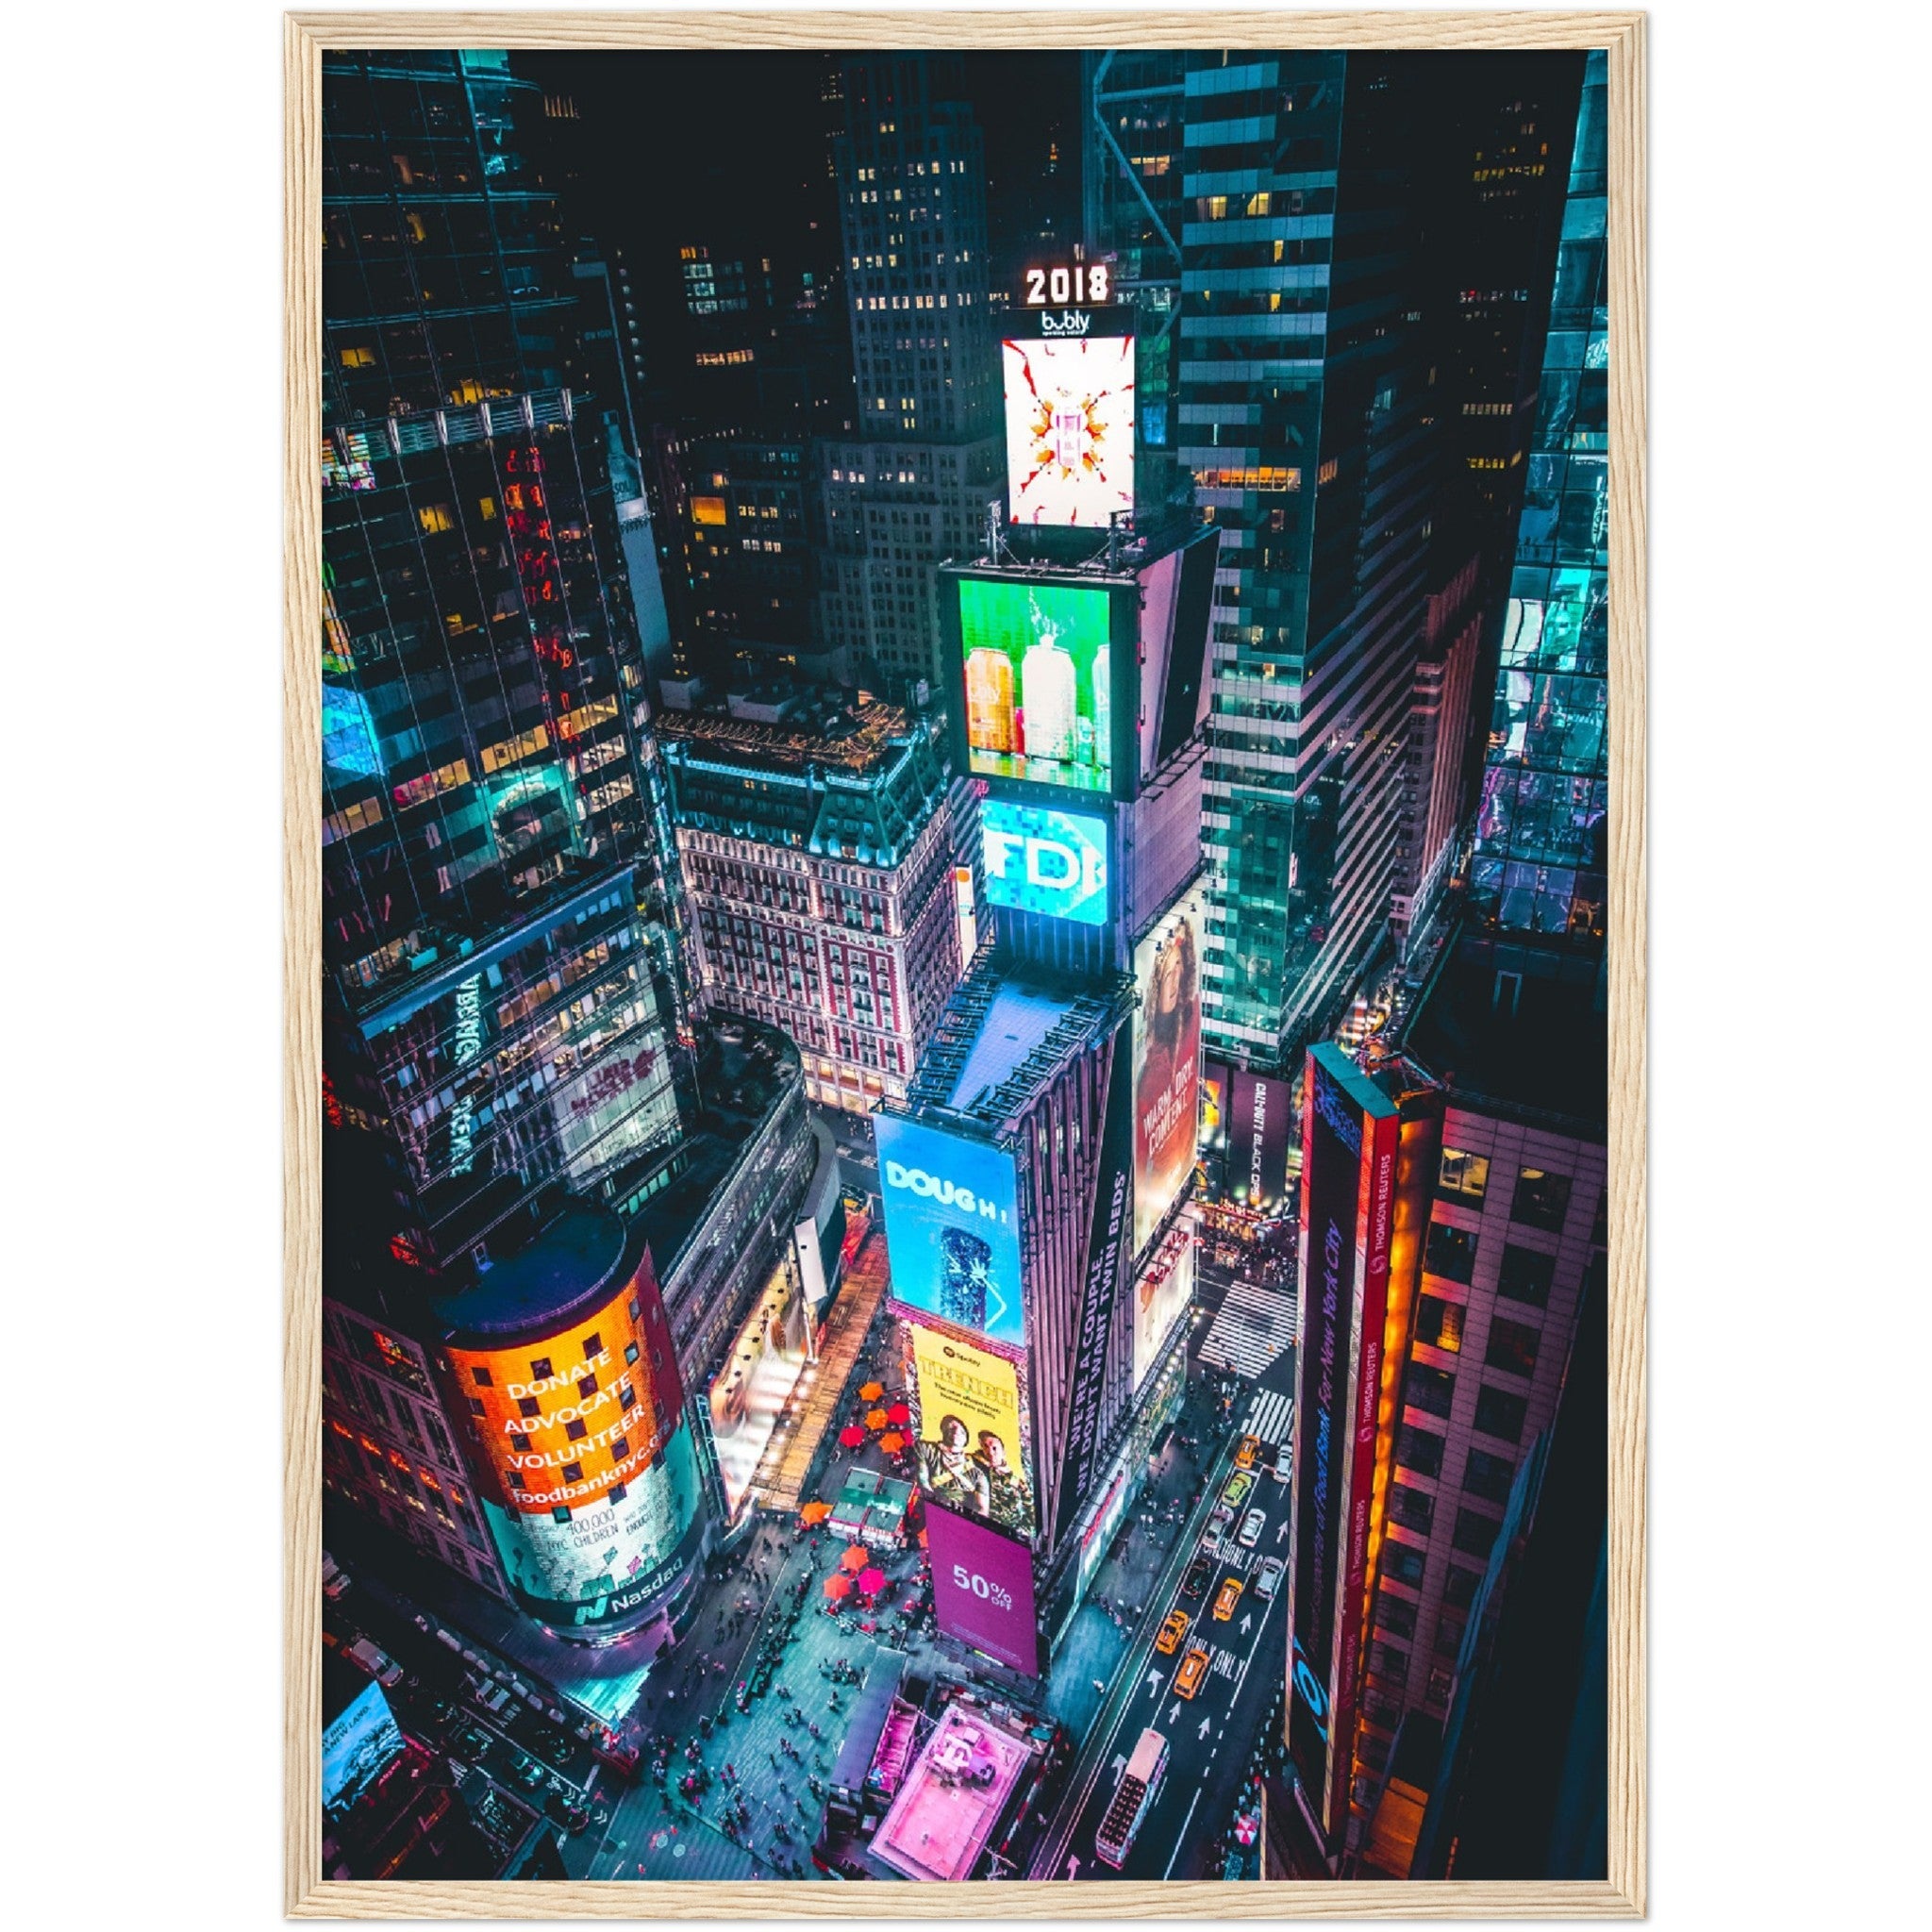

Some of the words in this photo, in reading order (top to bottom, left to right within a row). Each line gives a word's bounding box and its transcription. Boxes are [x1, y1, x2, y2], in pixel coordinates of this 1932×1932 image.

[1026, 265, 1108, 304] 2018
[1251, 1134, 1264, 1173] BLACK
[1379, 1154, 1391, 1199] REUTERS
[1249, 1174, 1261, 1197] OPS
[1324, 1217, 1342, 1270] City
[1375, 1201, 1389, 1250] THOMSON
[1082, 1248, 1104, 1349] COUPLE.
[1100, 1241, 1117, 1306] TWIN
[1323, 1269, 1338, 1320] York
[1080, 1352, 1091, 1369] A
[1090, 1313, 1108, 1382] WANT
[1321, 1321, 1335, 1375] New
[507, 1346, 612, 1400] DONATE
[919, 1356, 1014, 1409] TRENCH
[1318, 1374, 1332, 1411] For
[504, 1371, 633, 1433] ADVOCATE
[1081, 1386, 1098, 1456] DON'T
[508, 1404, 645, 1469] VOLUNTEER
[1315, 1407, 1330, 1454] Bank
[1076, 1457, 1089, 1497] WE
[574, 1523, 619, 1549] CHILDREN
[611, 1556, 684, 1613] Nasdaq
[954, 1564, 1012, 1605] 50%
[1213, 1650, 1247, 1682] ONLY
